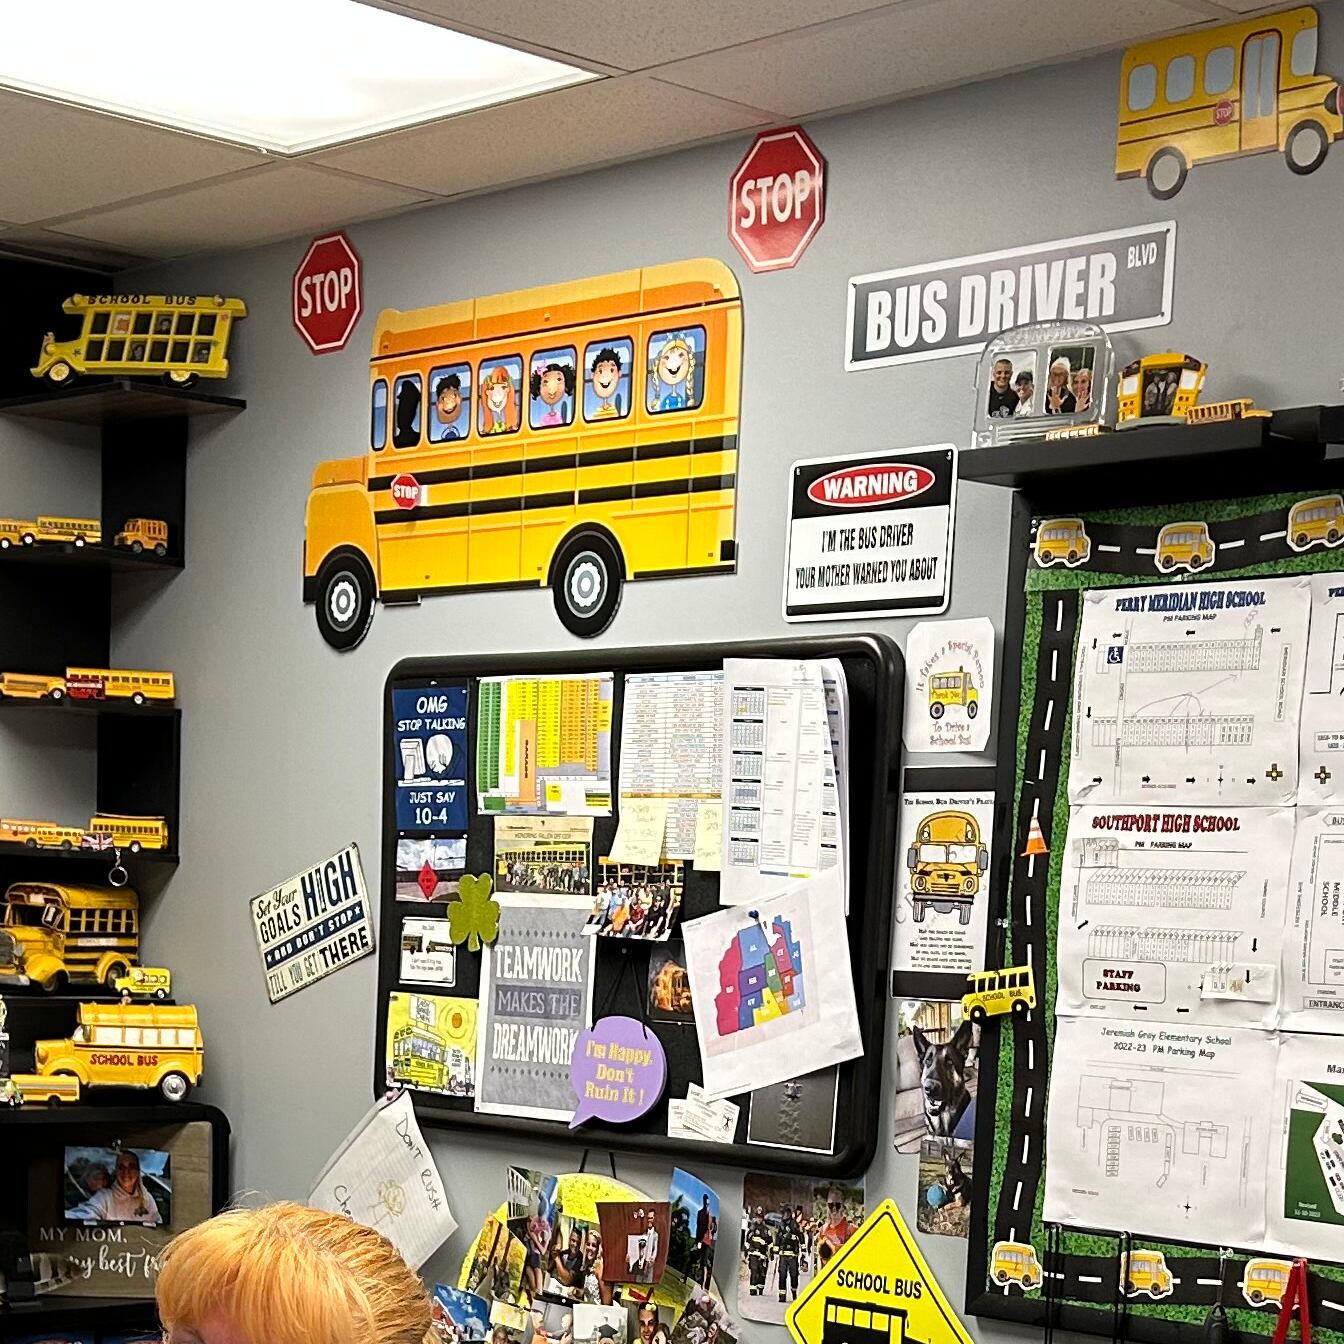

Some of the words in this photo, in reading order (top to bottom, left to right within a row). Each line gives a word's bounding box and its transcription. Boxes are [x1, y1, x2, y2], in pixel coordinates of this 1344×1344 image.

[739, 170, 812, 228] STOP
[299, 279, 353, 316] STOP
[865, 279, 949, 353] BUS
[958, 251, 1117, 338] DRIVER
[1127, 242, 1158, 270] BLVD
[393, 483, 419, 501] STOP
[823, 470, 919, 500] WARNING
[821, 529, 836, 553] I'M
[838, 527, 856, 550] THE
[858, 525, 877, 548] BUS
[879, 522, 914, 548] DRIVER
[795, 565, 815, 590] YOUR
[817, 562, 851, 588] MOTHER
[852, 560, 888, 587] WARNED
[889, 559, 908, 582] YOU
[908, 556, 938, 581] ABOUT
[1116, 598, 1146, 612] PERRY
[1150, 596, 1194, 612] MERIDIAN
[1197, 595, 1224, 610] HIGH
[1226, 592, 1266, 608] SCHOOL
[416, 695, 448, 714] OMG
[397, 719, 423, 733] STOP
[425, 717, 467, 732] TALKING
[409, 792, 432, 805] JUST
[434, 791, 456, 804] SAY
[415, 807, 449, 826] 10-4
[1092, 813, 1158, 833] SOUTHPORT
[1160, 813, 1191, 833] HIGH
[1193, 815, 1241, 832] SCHOOL
[256, 898, 273, 919] Set
[272, 880, 301, 910] Your
[258, 904, 302, 944] GOALS
[300, 850, 357, 921] HIGH
[273, 942, 292, 961] AND
[294, 927, 324, 951] DON'T
[328, 911, 354, 933] STOP
[269, 975, 288, 996] TILL
[289, 964, 305, 985] YOU
[305, 952, 320, 978] GET
[319, 927, 370, 969] THERE
[494, 945, 583, 983] TEAMWORK
[497, 990, 544, 1013] MAKES
[548, 992, 579, 1017] THE
[492, 1022, 580, 1065] DREAMWORK
[586, 1039, 606, 1059] I'm
[89, 1054, 134, 1066] SCHOOL
[137, 1055, 158, 1066] BUS
[596, 1063, 634, 1083] Don't
[584, 1081, 619, 1101] Ruin
[835, 1268, 888, 1295] SCHOOL
[892, 1277, 923, 1301] BUS
